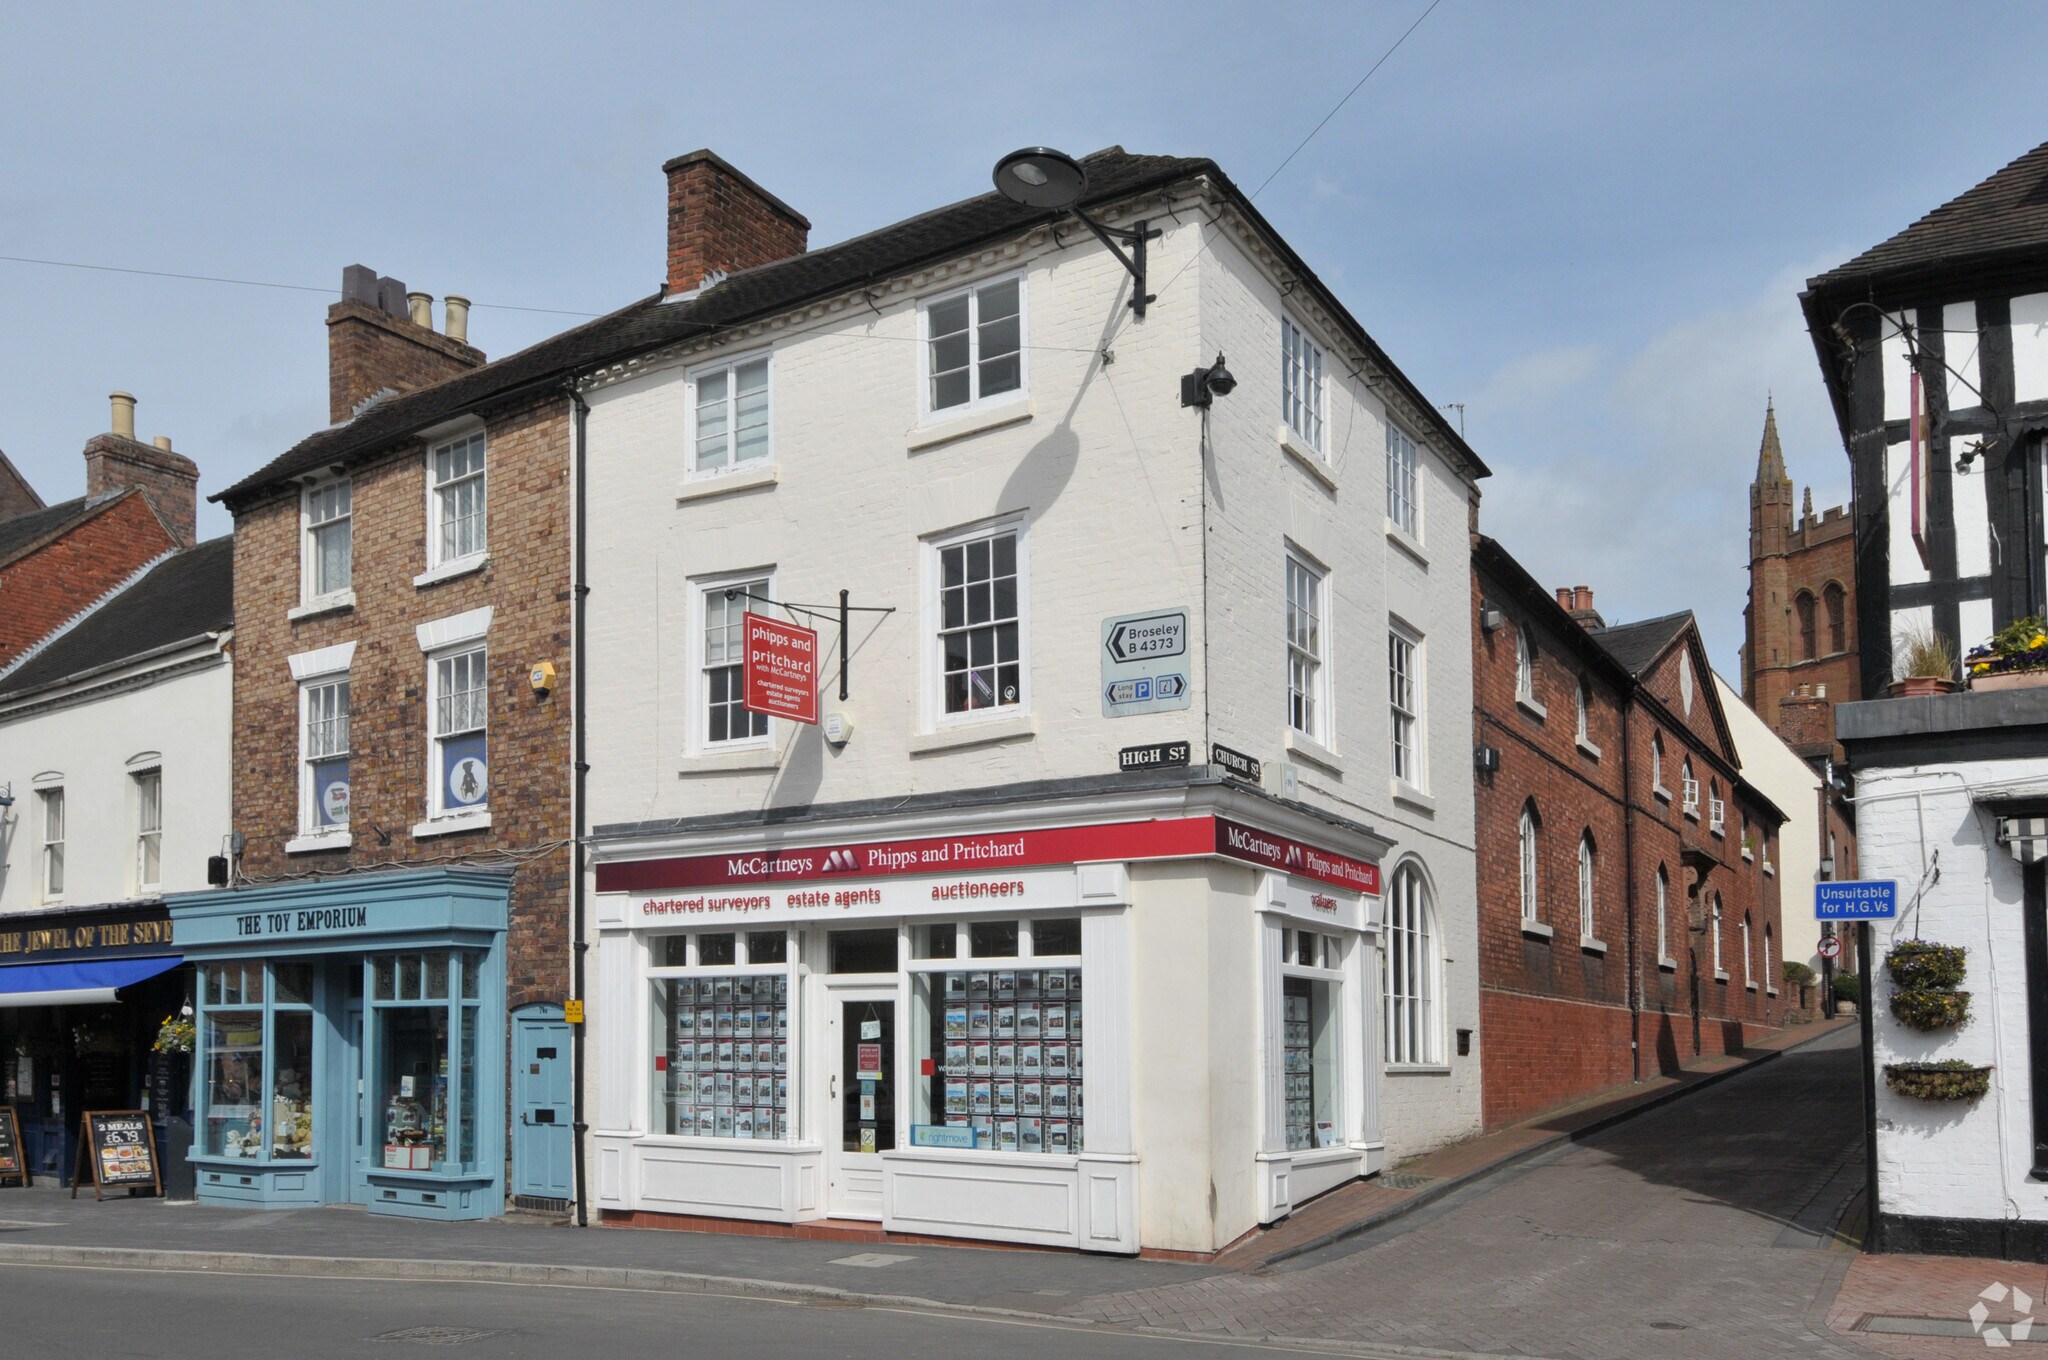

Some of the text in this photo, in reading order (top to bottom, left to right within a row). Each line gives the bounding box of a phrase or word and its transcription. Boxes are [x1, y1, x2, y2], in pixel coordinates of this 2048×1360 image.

[752, 627, 811, 652] phipps and
[1129, 624, 1179, 639] Broseley
[1129, 637, 1173, 653] B 4373
[752, 650, 811, 673] pritchard
[756, 664, 807, 684] with McCartneys
[757, 679, 809, 697] chartered surveyors
[766, 690, 801, 703] estate agents
[1117, 684, 1133, 692] Long
[1138, 683, 1148, 697] P
[768, 699, 799, 710] auctioneers
[1122, 749, 1161, 766] HIGH
[1215, 748, 1248, 772] CHURCH
[728, 838, 1025, 878] McCartneys Phipps and Pritchard
[1228, 826, 1373, 885] McCartneys Phipps and Pritchard
[643, 881, 1025, 915] chartered surveyors estate agents auctioneers
[1821, 886, 1891, 900] Unsuitable
[1310, 892, 1338, 912] valuers
[1822, 900, 1889, 913] for H.G.Vs
[237, 907, 367, 935] THE TOY EMPORIUM
[25, 927, 71, 954] JEWEL
[75, 926, 95, 948] OF
[99, 923, 129, 946] THE
[98, 1124, 106, 1132] 2
[108, 1122, 143, 1131] MEALS
[928, 1133, 968, 1144] rightmove
